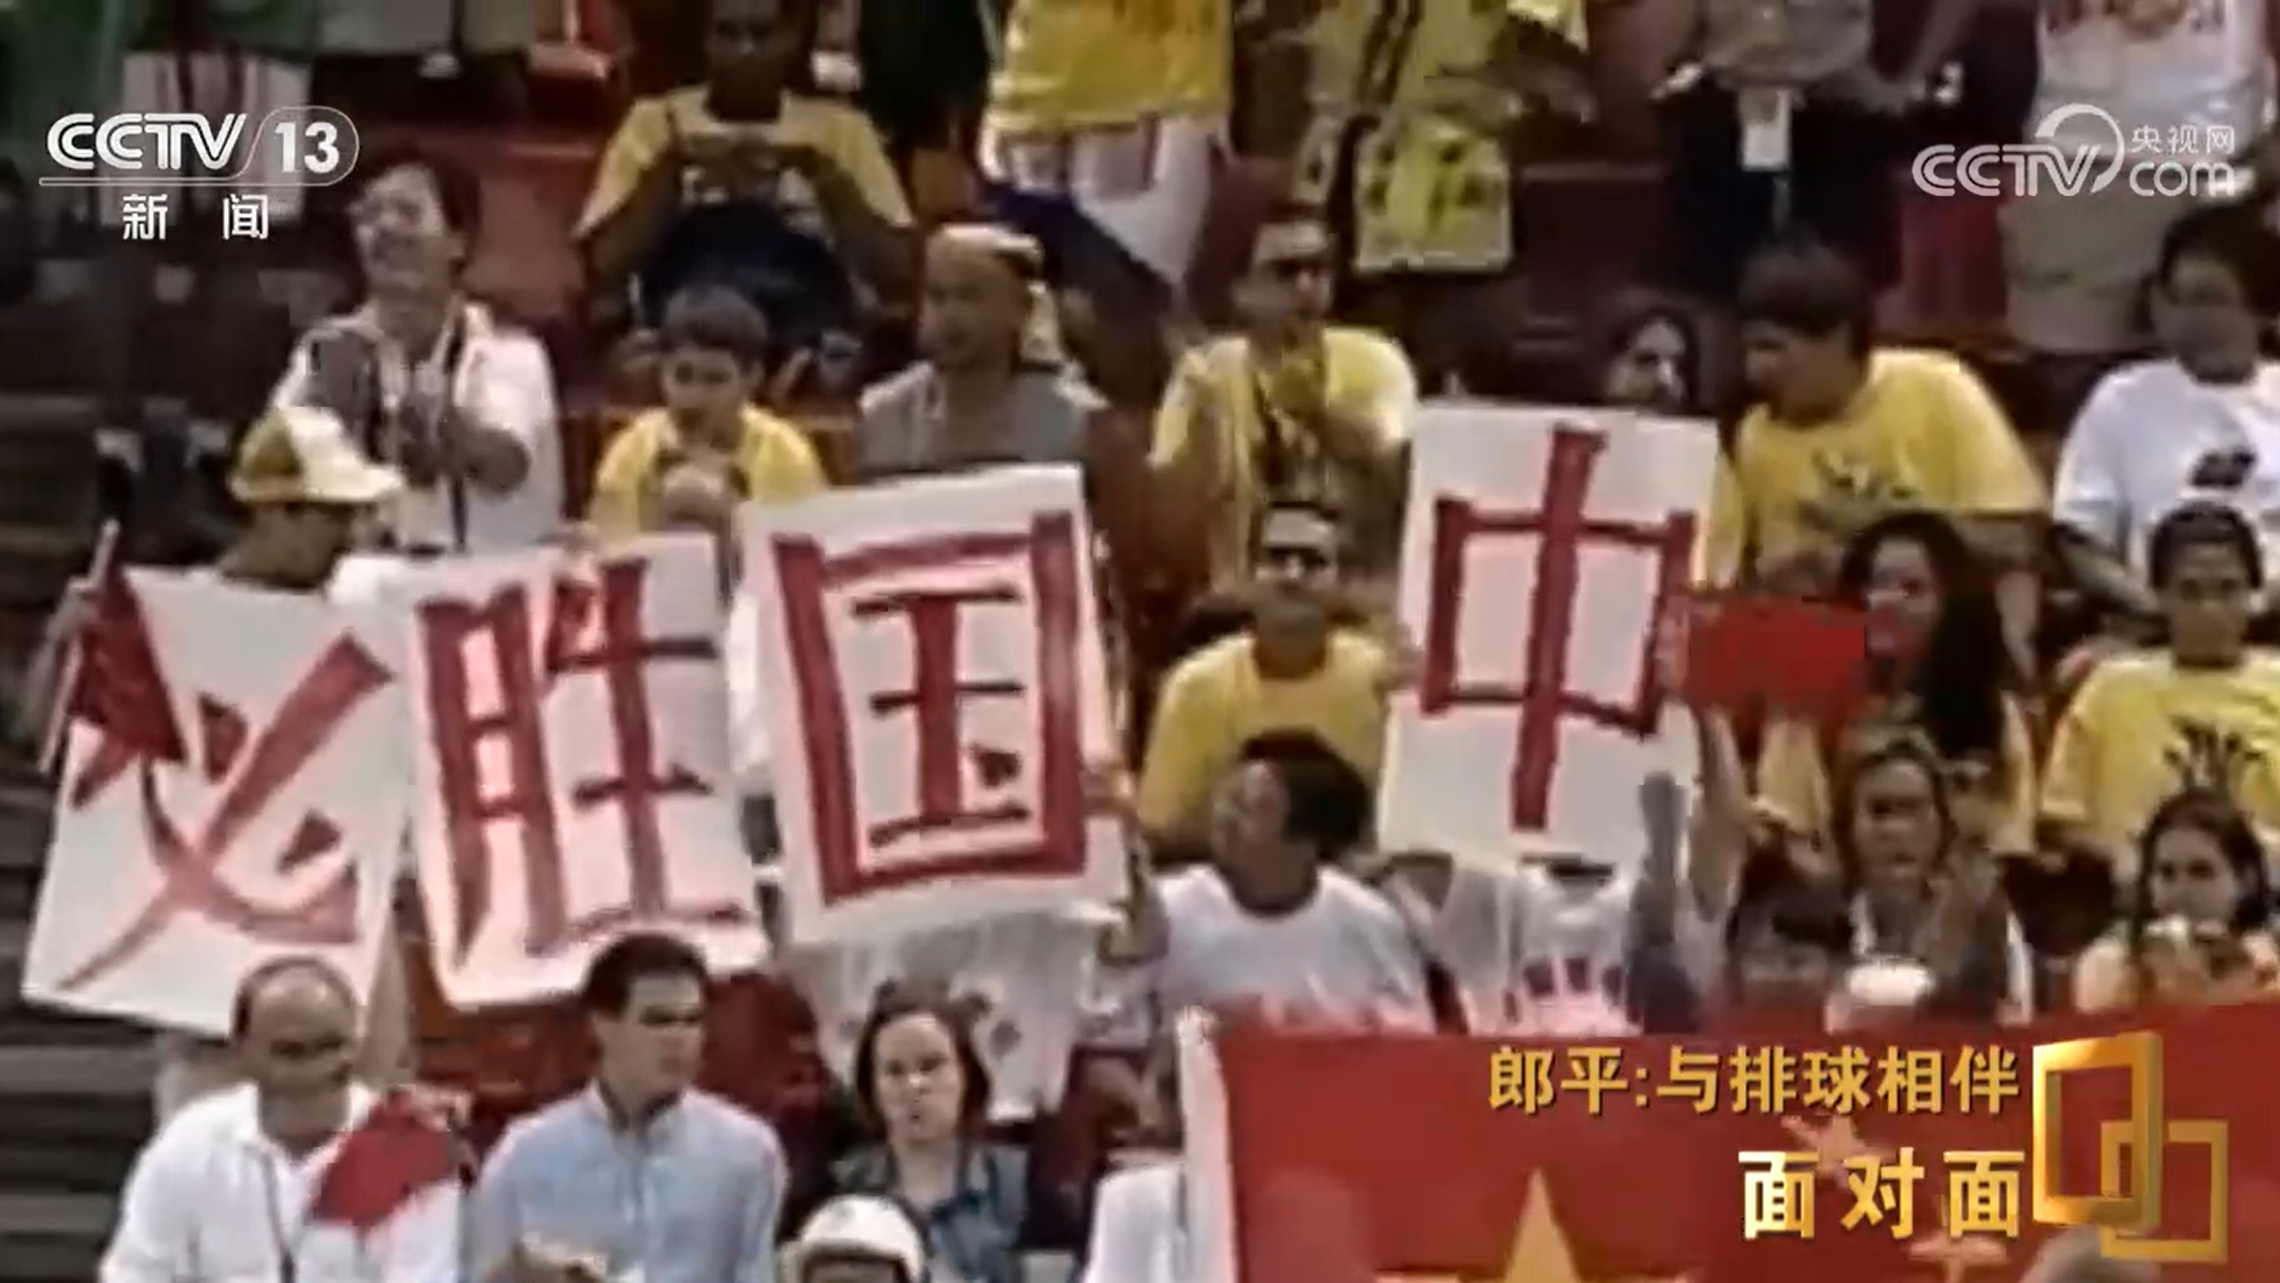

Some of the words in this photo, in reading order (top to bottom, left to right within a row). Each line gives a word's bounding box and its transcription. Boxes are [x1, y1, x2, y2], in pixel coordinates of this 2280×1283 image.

[60, 630, 390, 990] 必
[415, 556, 752, 964] 胜
[770, 511, 1089, 906] 国
[1420, 422, 1698, 833] 中
